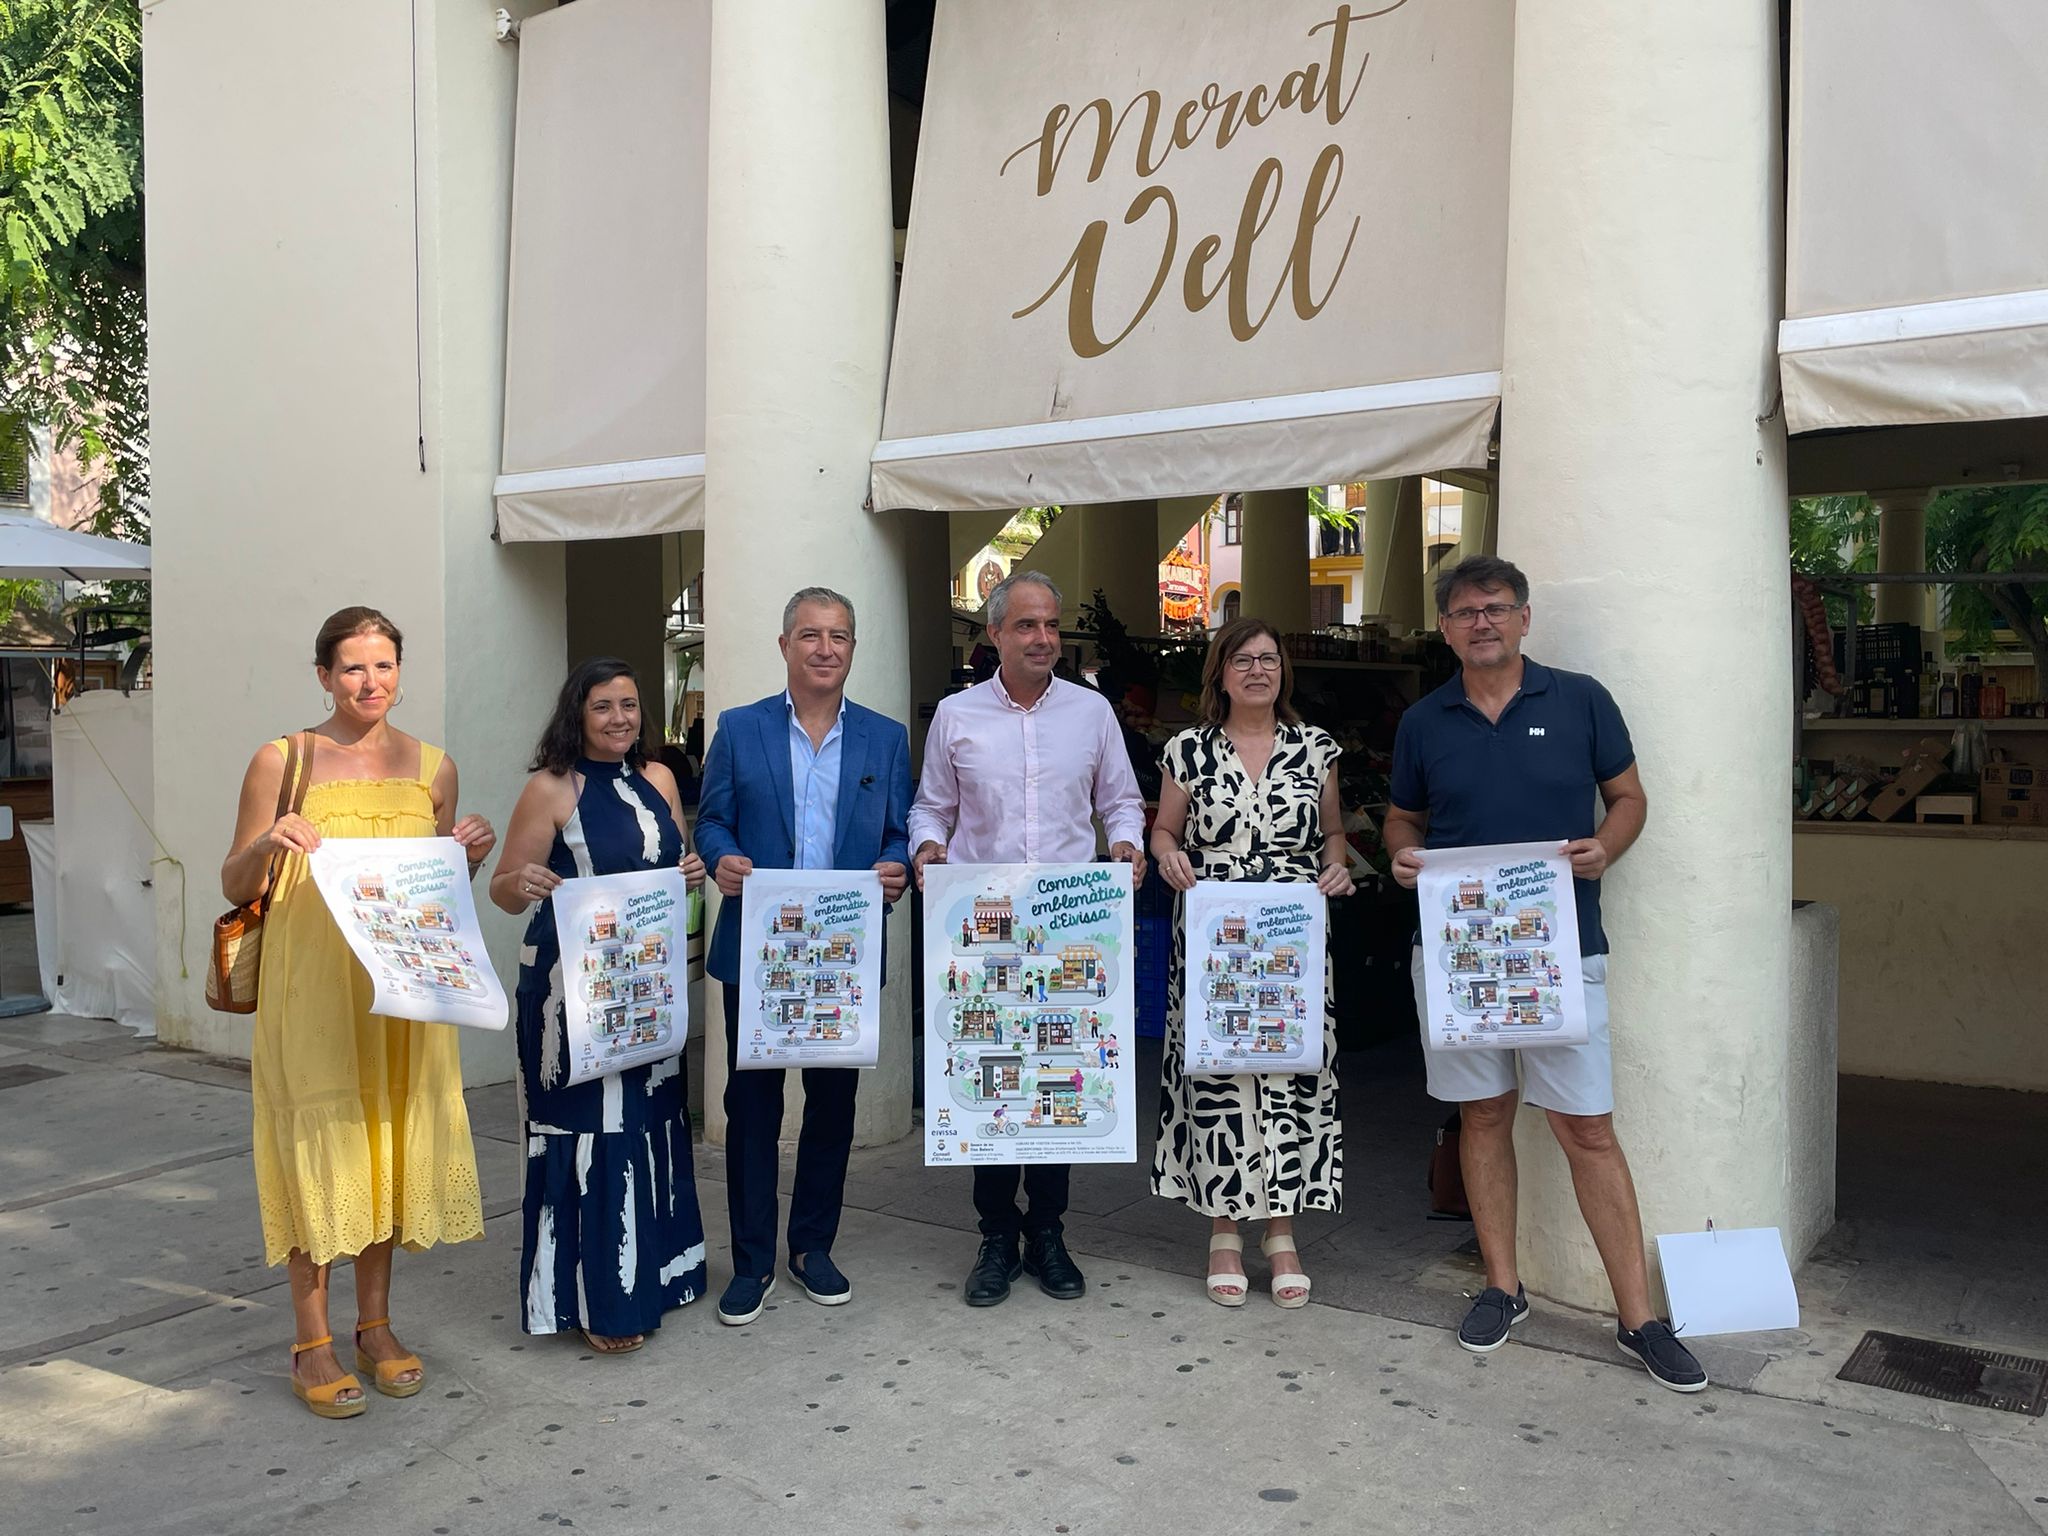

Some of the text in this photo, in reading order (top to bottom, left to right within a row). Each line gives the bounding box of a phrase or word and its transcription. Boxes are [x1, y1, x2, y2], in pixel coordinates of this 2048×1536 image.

[1000, 0, 1406, 196] Mercat
[1012, 144, 1360, 358] Vell
[1498, 860, 1547, 878] Comerços
[1037, 869, 1112, 893] Comerços
[818, 889, 862, 904] Comerços
[1031, 885, 1126, 916] emblemàtics
[1049, 908, 1111, 930] d'Eivissa
[1260, 903, 1304, 916] Comerços
[931, 1129, 958, 1137] eivissa
